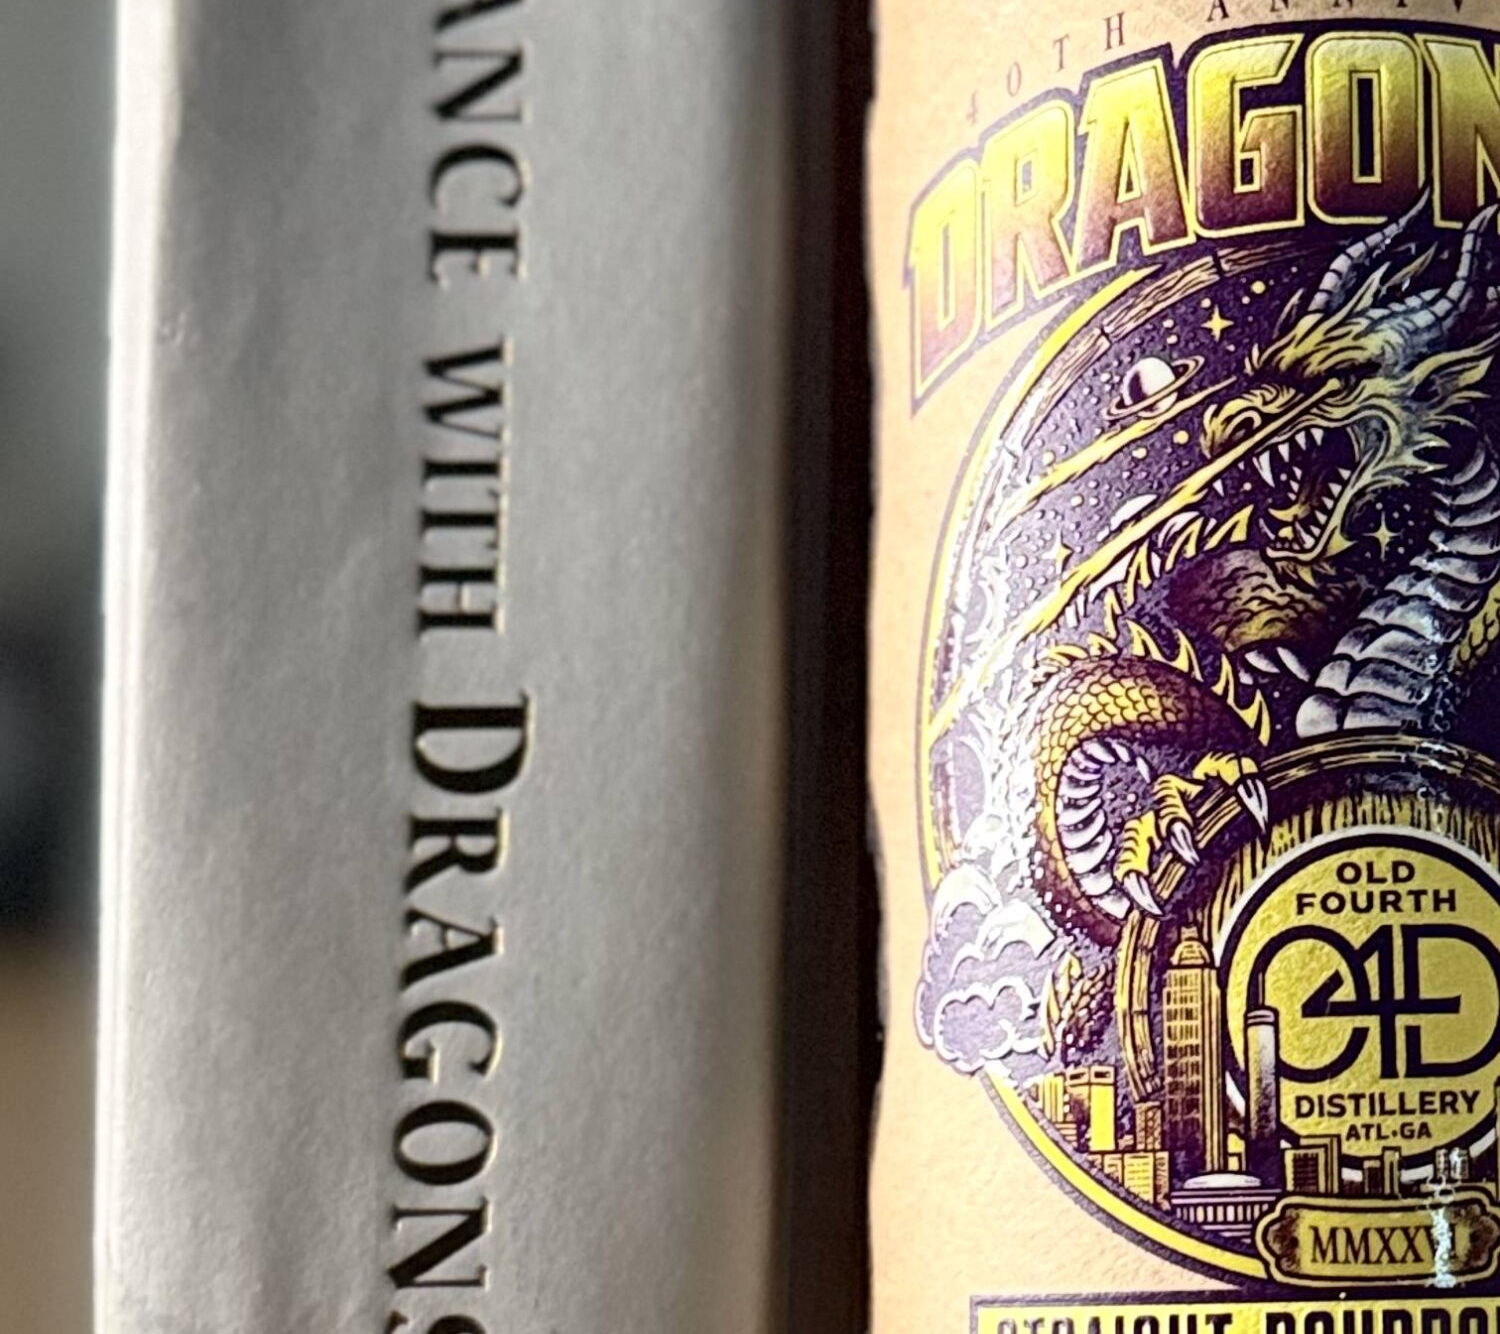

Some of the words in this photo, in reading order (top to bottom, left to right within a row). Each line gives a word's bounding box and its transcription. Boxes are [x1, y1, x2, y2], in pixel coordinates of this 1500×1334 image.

[417, 335, 514, 635] WITH
[1336, 860, 1416, 884] OLD
[1297, 888, 1456, 915] FOURTH
[1295, 1089, 1481, 1119] DISTILLERY
